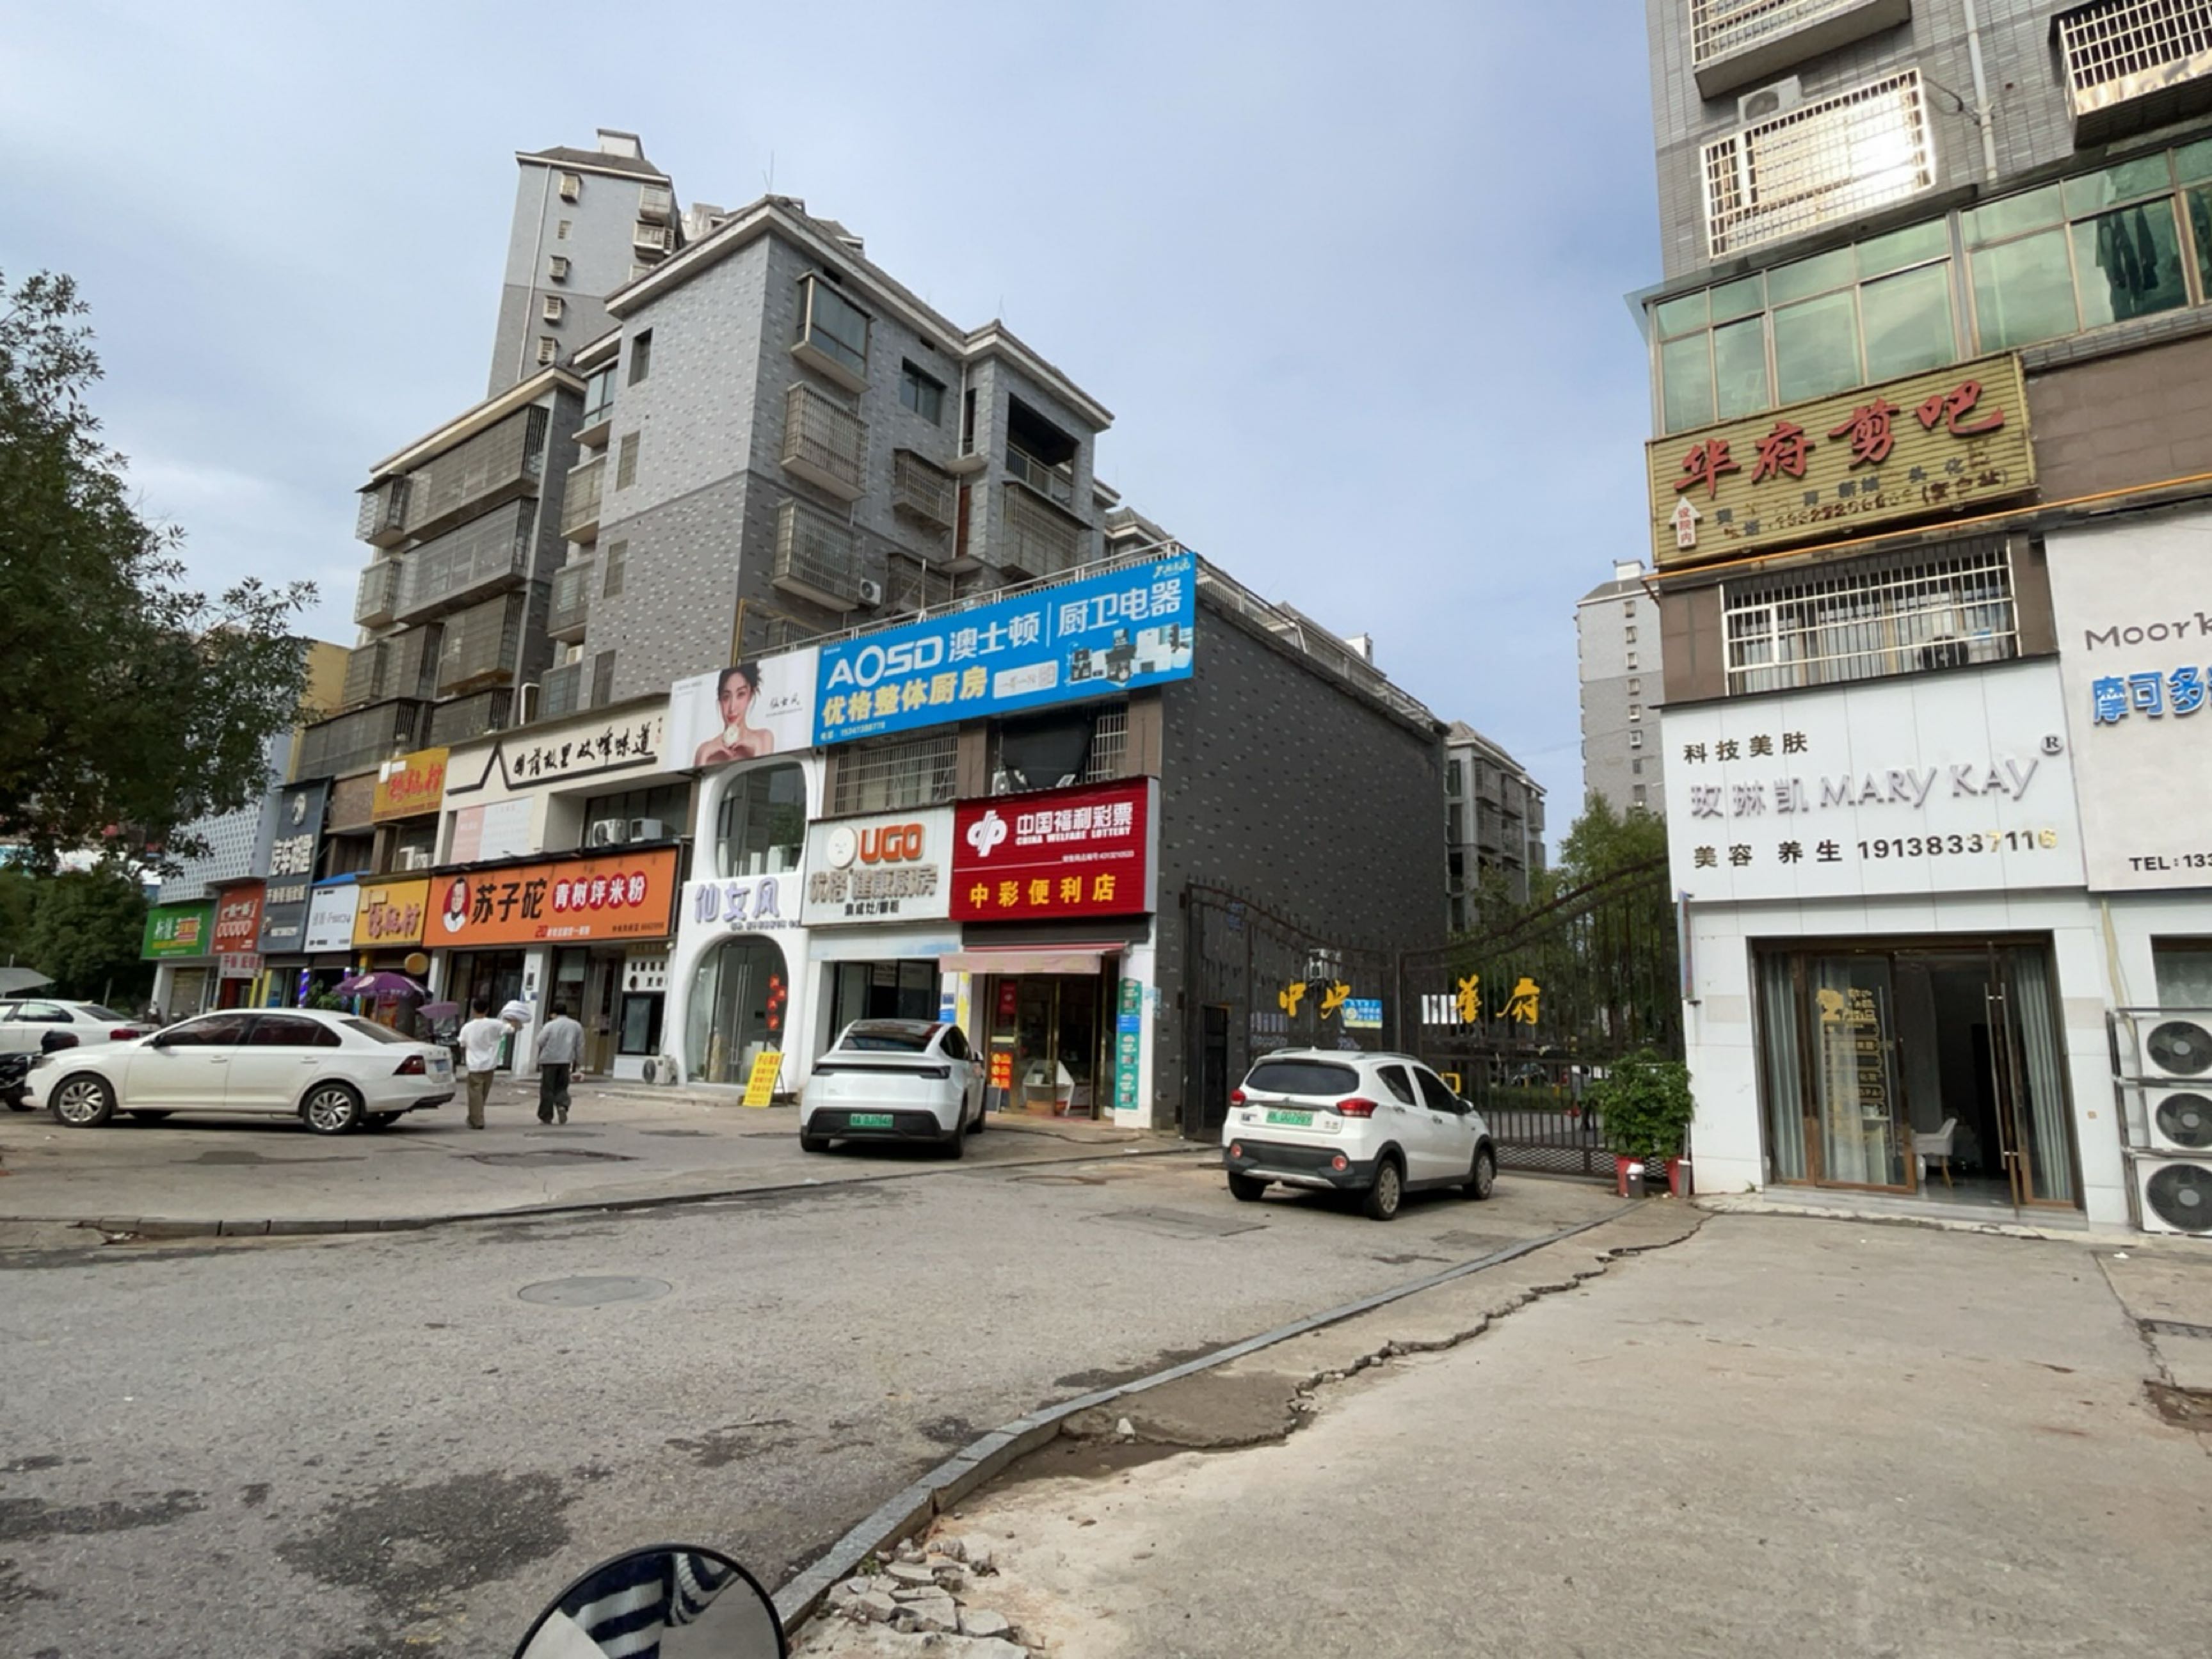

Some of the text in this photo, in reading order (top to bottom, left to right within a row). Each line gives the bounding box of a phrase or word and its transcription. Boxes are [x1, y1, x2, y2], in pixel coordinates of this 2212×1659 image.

[1673, 380, 2004, 500] 华府剪吧
[1057, 578, 1182, 637] 厨卫电器
[826, 610, 1041, 691] AOSD 澳士顿
[822, 666, 989, 728] 优格整体厨房
[2092, 666, 2212, 726] 摩可多
[1683, 732, 1808, 764] 科技美肤
[1017, 802, 1133, 834] 中国福利彩票
[1690, 778, 1809, 819] 玫琳凯
[860, 823, 926, 864] UGO
[1015, 826, 1131, 846] CHINA WELFARE LOTTERY
[1693, 830, 2058, 869] 美容 养生 19138337116
[694, 878, 780, 922] 仙女风
[969, 874, 1116, 908] 中彩便利店
